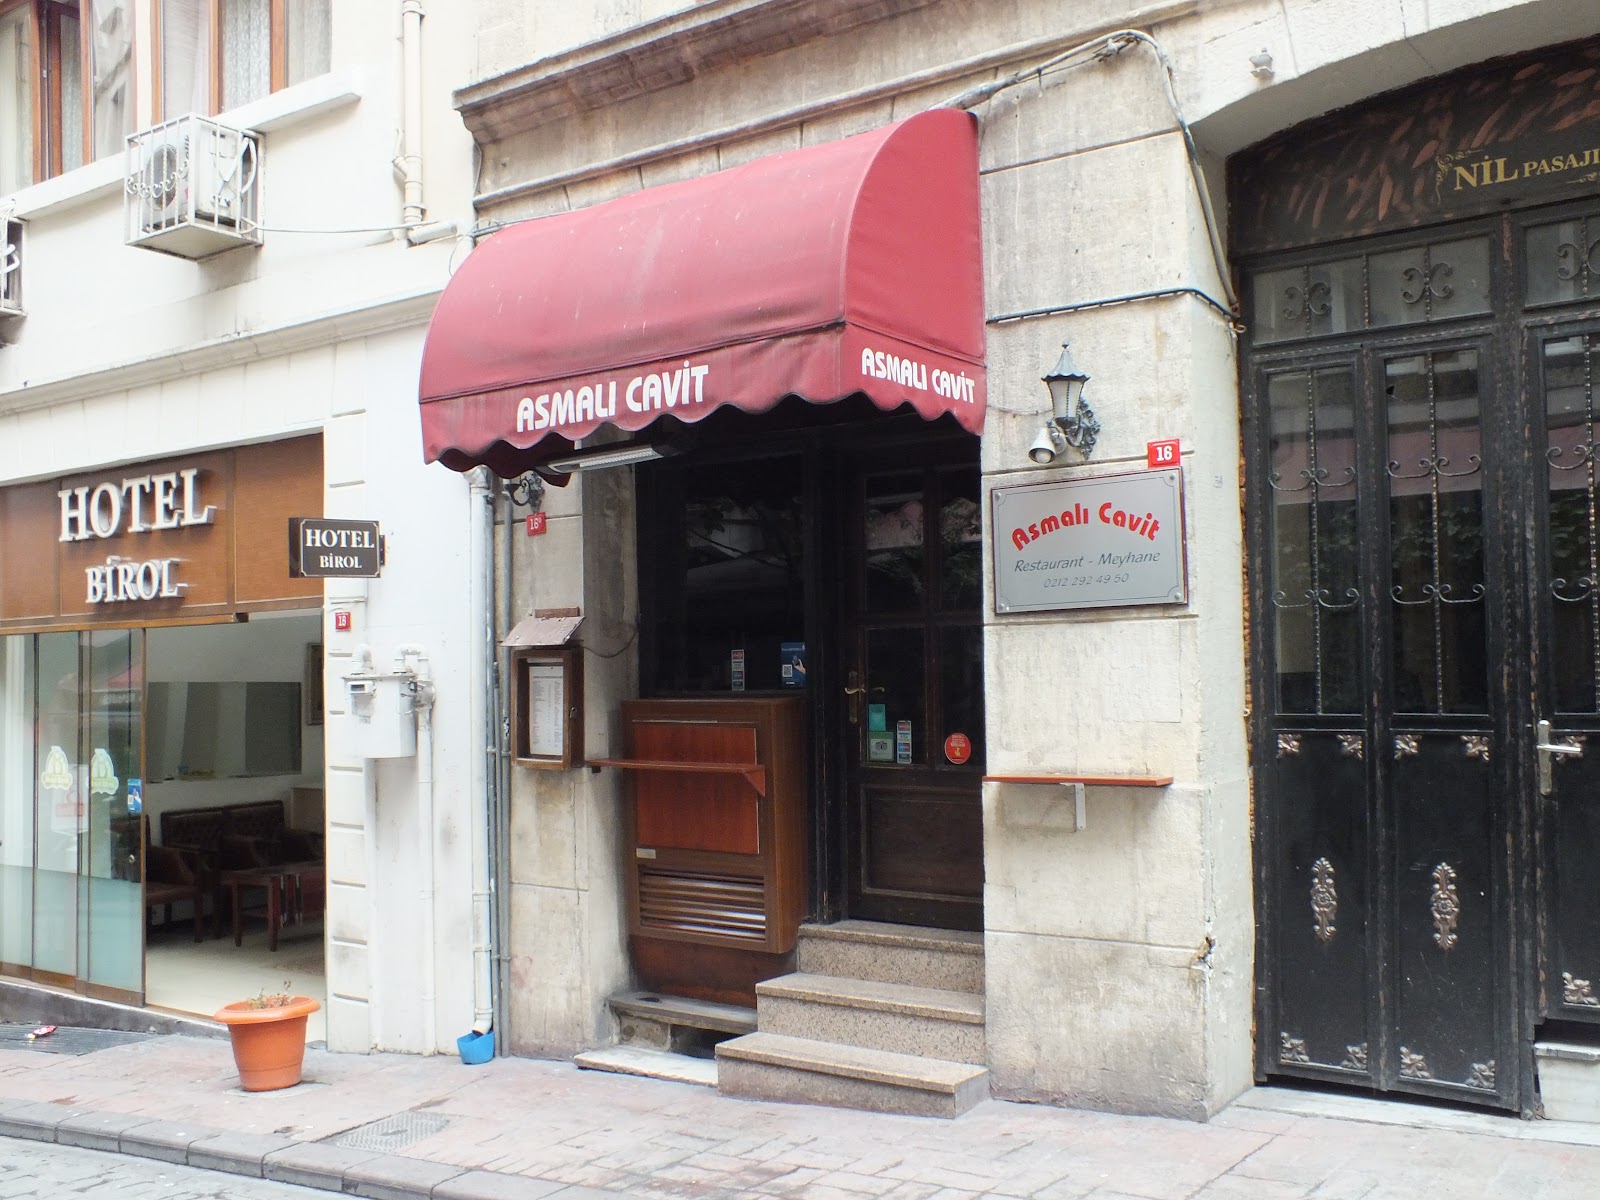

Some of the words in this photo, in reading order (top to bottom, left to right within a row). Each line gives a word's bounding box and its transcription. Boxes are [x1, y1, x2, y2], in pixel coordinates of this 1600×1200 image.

[1454, 156, 1518, 190] NİL
[861, 347, 928, 391] ASMALI
[931, 371, 975, 404] CAVİT
[516, 381, 616, 432] ASMALI
[626, 360, 710, 413] CAVİT
[1156, 446, 1173, 461] 16
[58, 468, 217, 542] HOTEL
[305, 529, 374, 549] HOTEL
[1011, 503, 1089, 551] Asmalı
[1098, 502, 1160, 541] Cavit
[320, 553, 362, 569] BİROL
[1014, 555, 1084, 572] Restaurant
[1098, 551, 1161, 567] Meyhane
[85, 556, 190, 604] BİROL
[1044, 578, 1067, 588] 0212
[1072, 576, 1092, 586] 292
[1096, 574, 1110, 584] 49
[1114, 573, 1129, 583] 50
